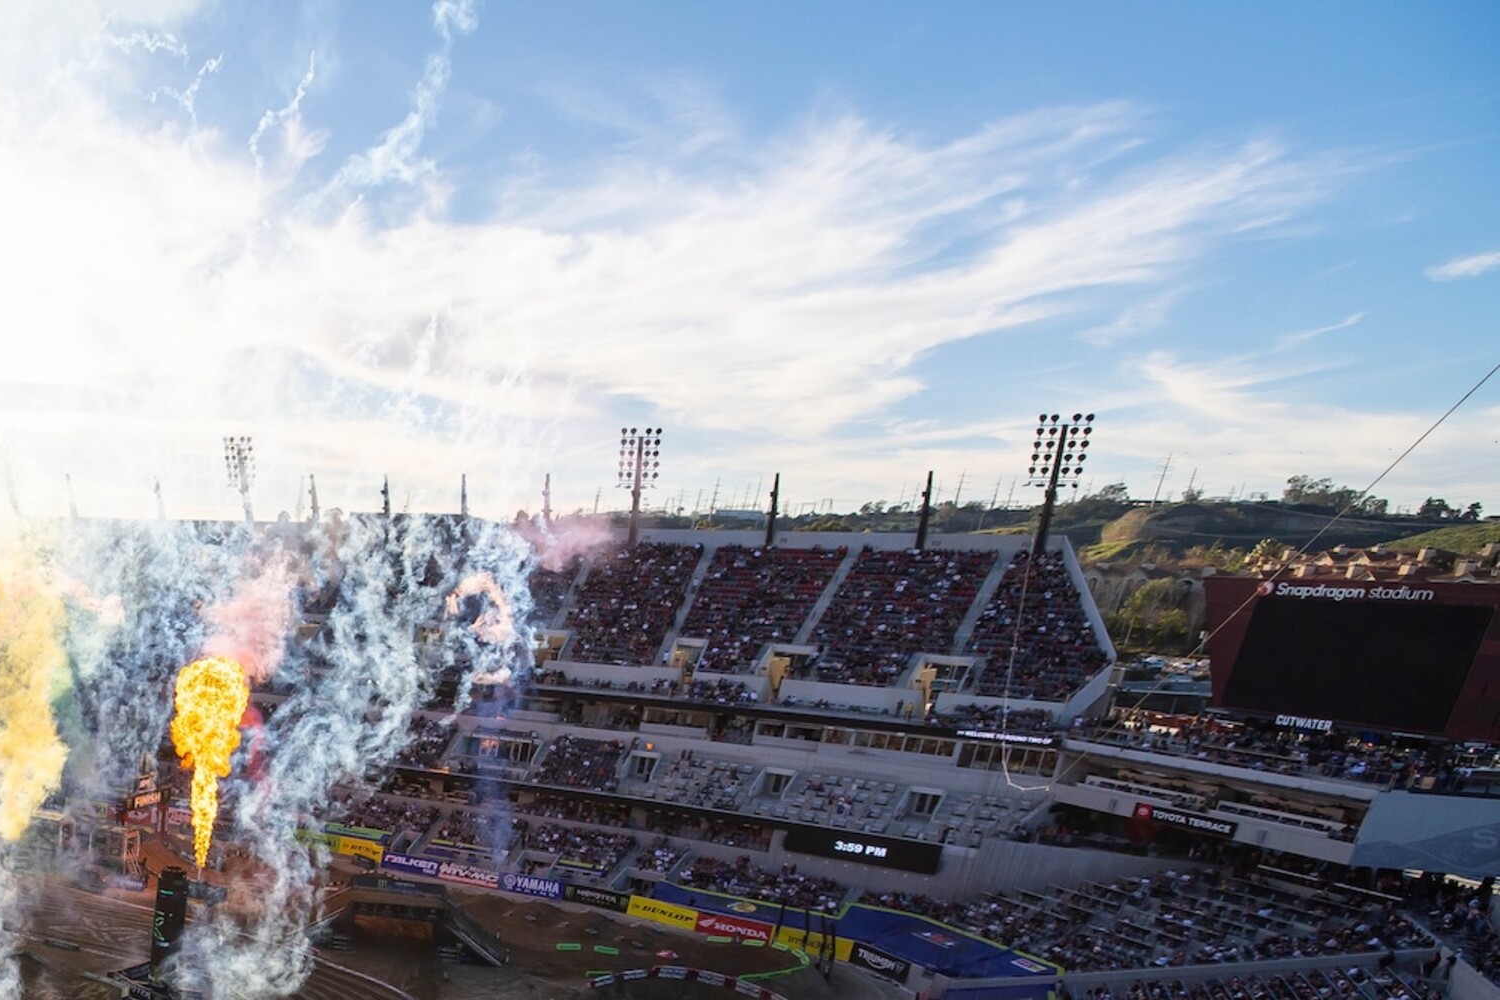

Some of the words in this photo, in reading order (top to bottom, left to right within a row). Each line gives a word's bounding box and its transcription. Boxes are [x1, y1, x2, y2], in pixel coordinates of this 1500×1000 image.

[1275, 582, 1365, 601] Snapdragon
[1368, 585, 1434, 600] stadium
[1275, 714, 1332, 731] CUTWATER
[1152, 810, 1186, 824] TOYOTA
[1188, 817, 1231, 833] TERRACE
[834, 841, 863, 853] 3:59
[865, 845, 887, 857] PM
[385, 854, 438, 870] FALKEN
[516, 876, 560, 894] YAMAHA
[642, 905, 694, 922] DUNLOP
[714, 922, 768, 939] HONDA
[858, 948, 896, 970] TRIUMPH
